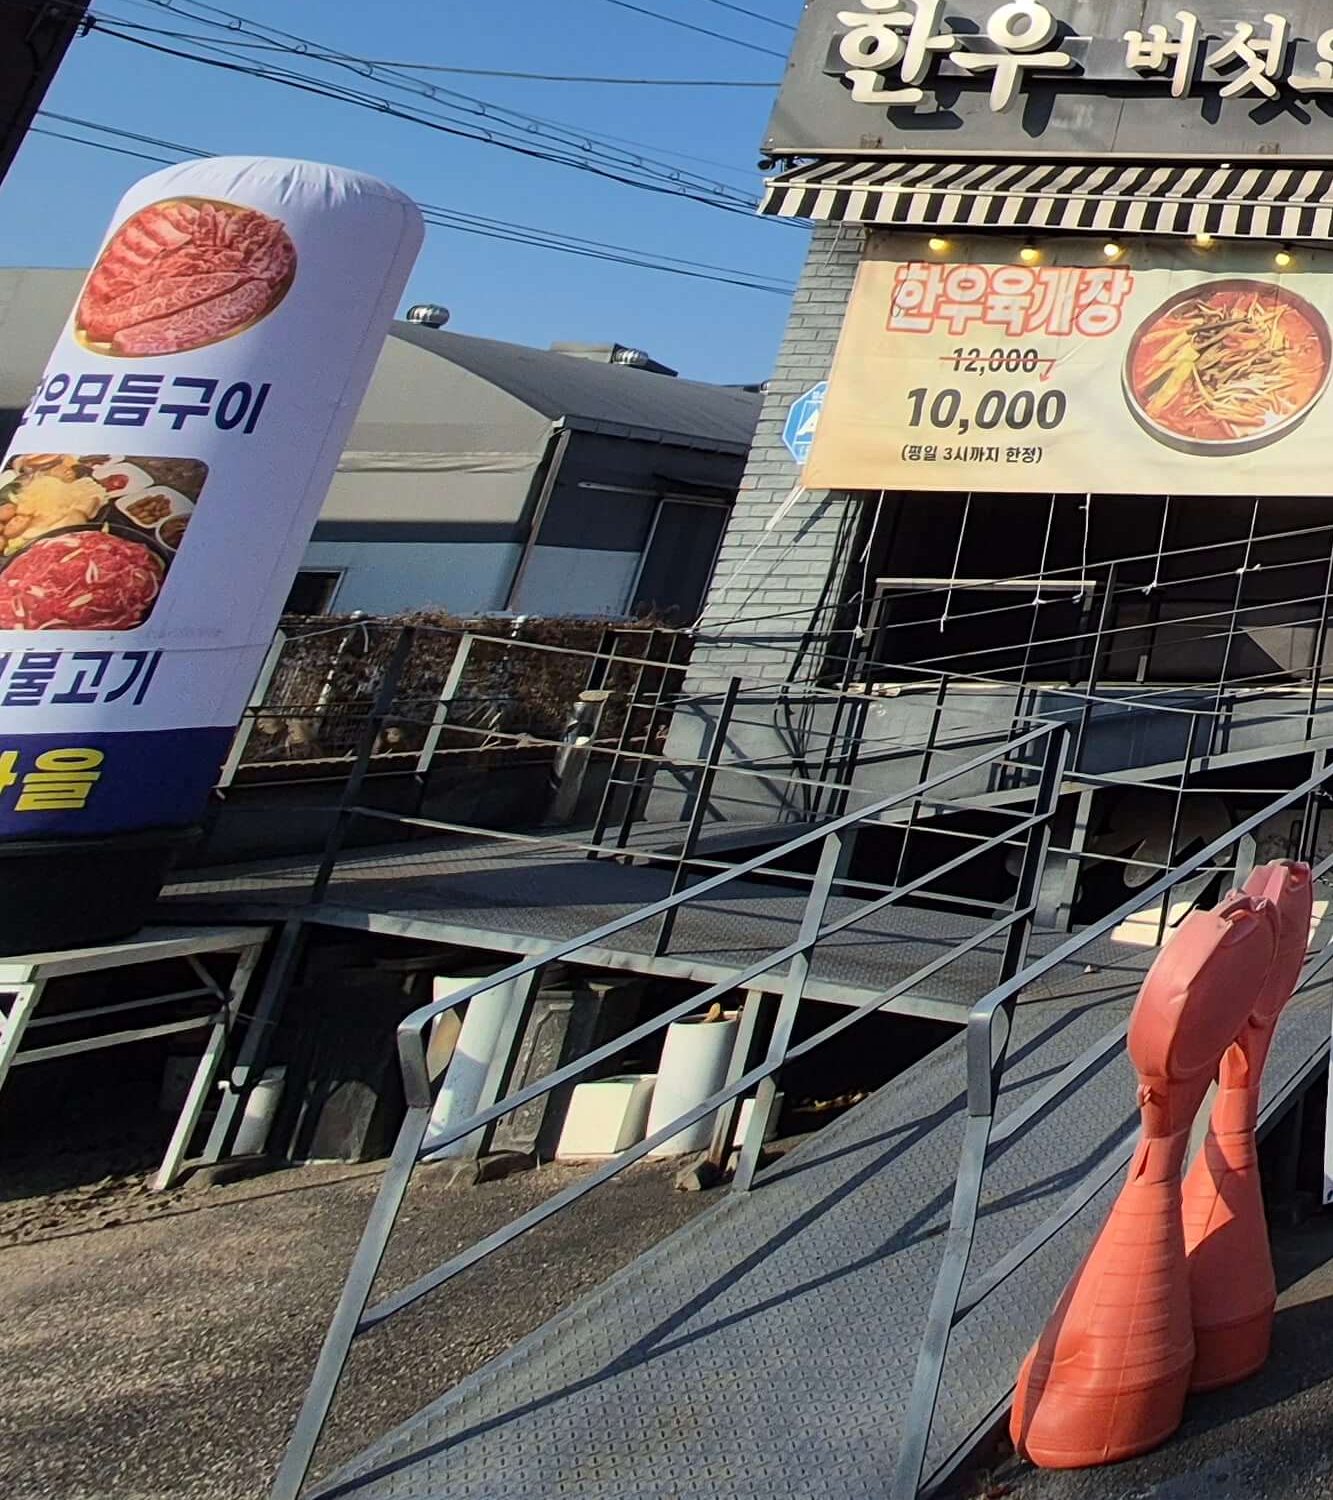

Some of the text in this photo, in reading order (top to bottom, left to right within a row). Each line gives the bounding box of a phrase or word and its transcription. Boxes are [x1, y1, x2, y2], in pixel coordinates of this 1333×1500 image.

[886, 260, 1133, 337] 한우육개장
[952, 348, 1038, 374] 12,000
[907, 388, 1066, 434] 10,000
[901, 445, 1042, 464] (평일 3시까지 한정)
[0, 648, 163, 706] 불고기
